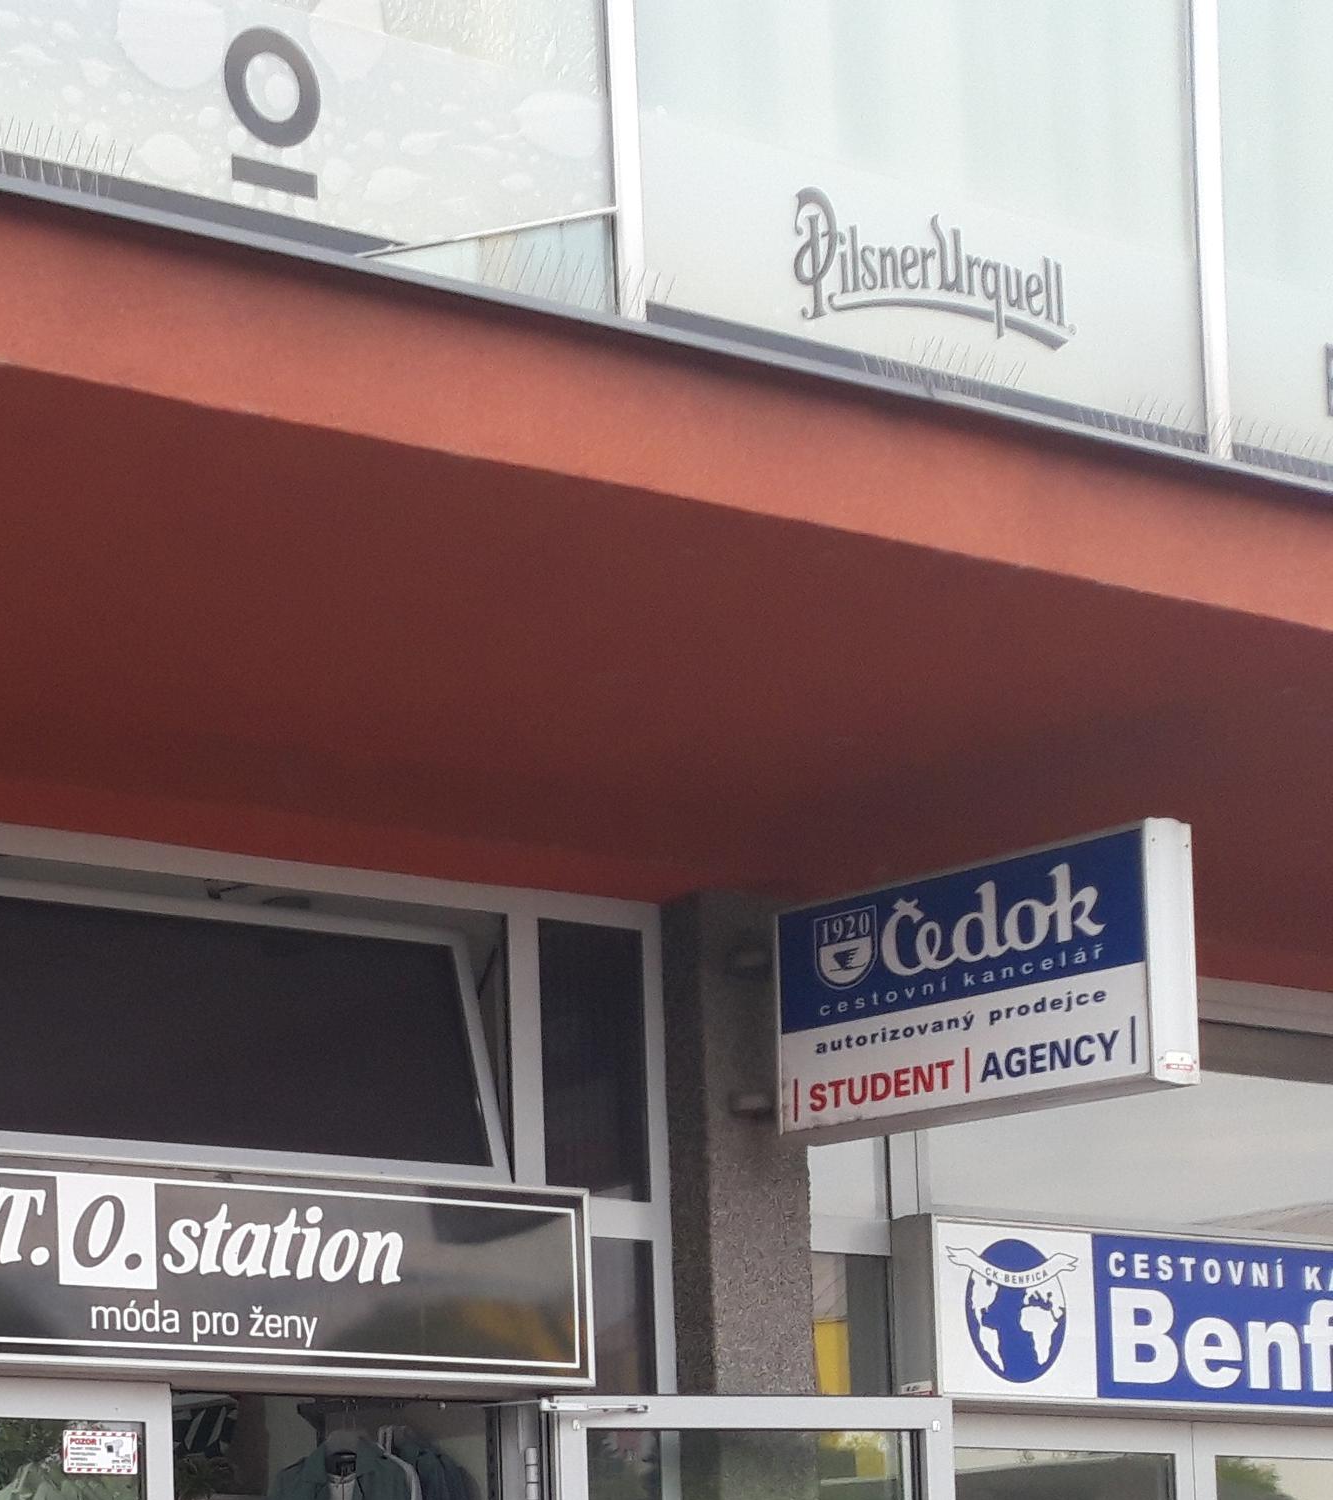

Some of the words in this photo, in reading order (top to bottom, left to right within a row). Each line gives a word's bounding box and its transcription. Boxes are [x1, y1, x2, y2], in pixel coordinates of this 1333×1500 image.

[793, 185, 937, 322] Pilsner
[930, 213, 1067, 339] Urquell
[820, 911, 871, 945] 1920
[880, 862, 1106, 977] Čedok
[819, 976, 949, 1017] cestovní
[963, 943, 1105, 988] kancelář
[815, 1009, 975, 1055] autorizovaný
[988, 987, 1108, 1027] prodejce
[809, 1059, 955, 1113] STUDENT
[980, 1029, 1121, 1083] AGENCY
[985, 1267, 999, 1279] CK
[1004, 1269, 1048, 1284] BENFICA
[1108, 1249, 1284, 1289] CESTOVNÍ
[1305, 1265, 1333, 1291] K
[90, 1298, 181, 1336] móda
[191, 1310, 240, 1343] pro
[249, 1302, 319, 1348] ženy
